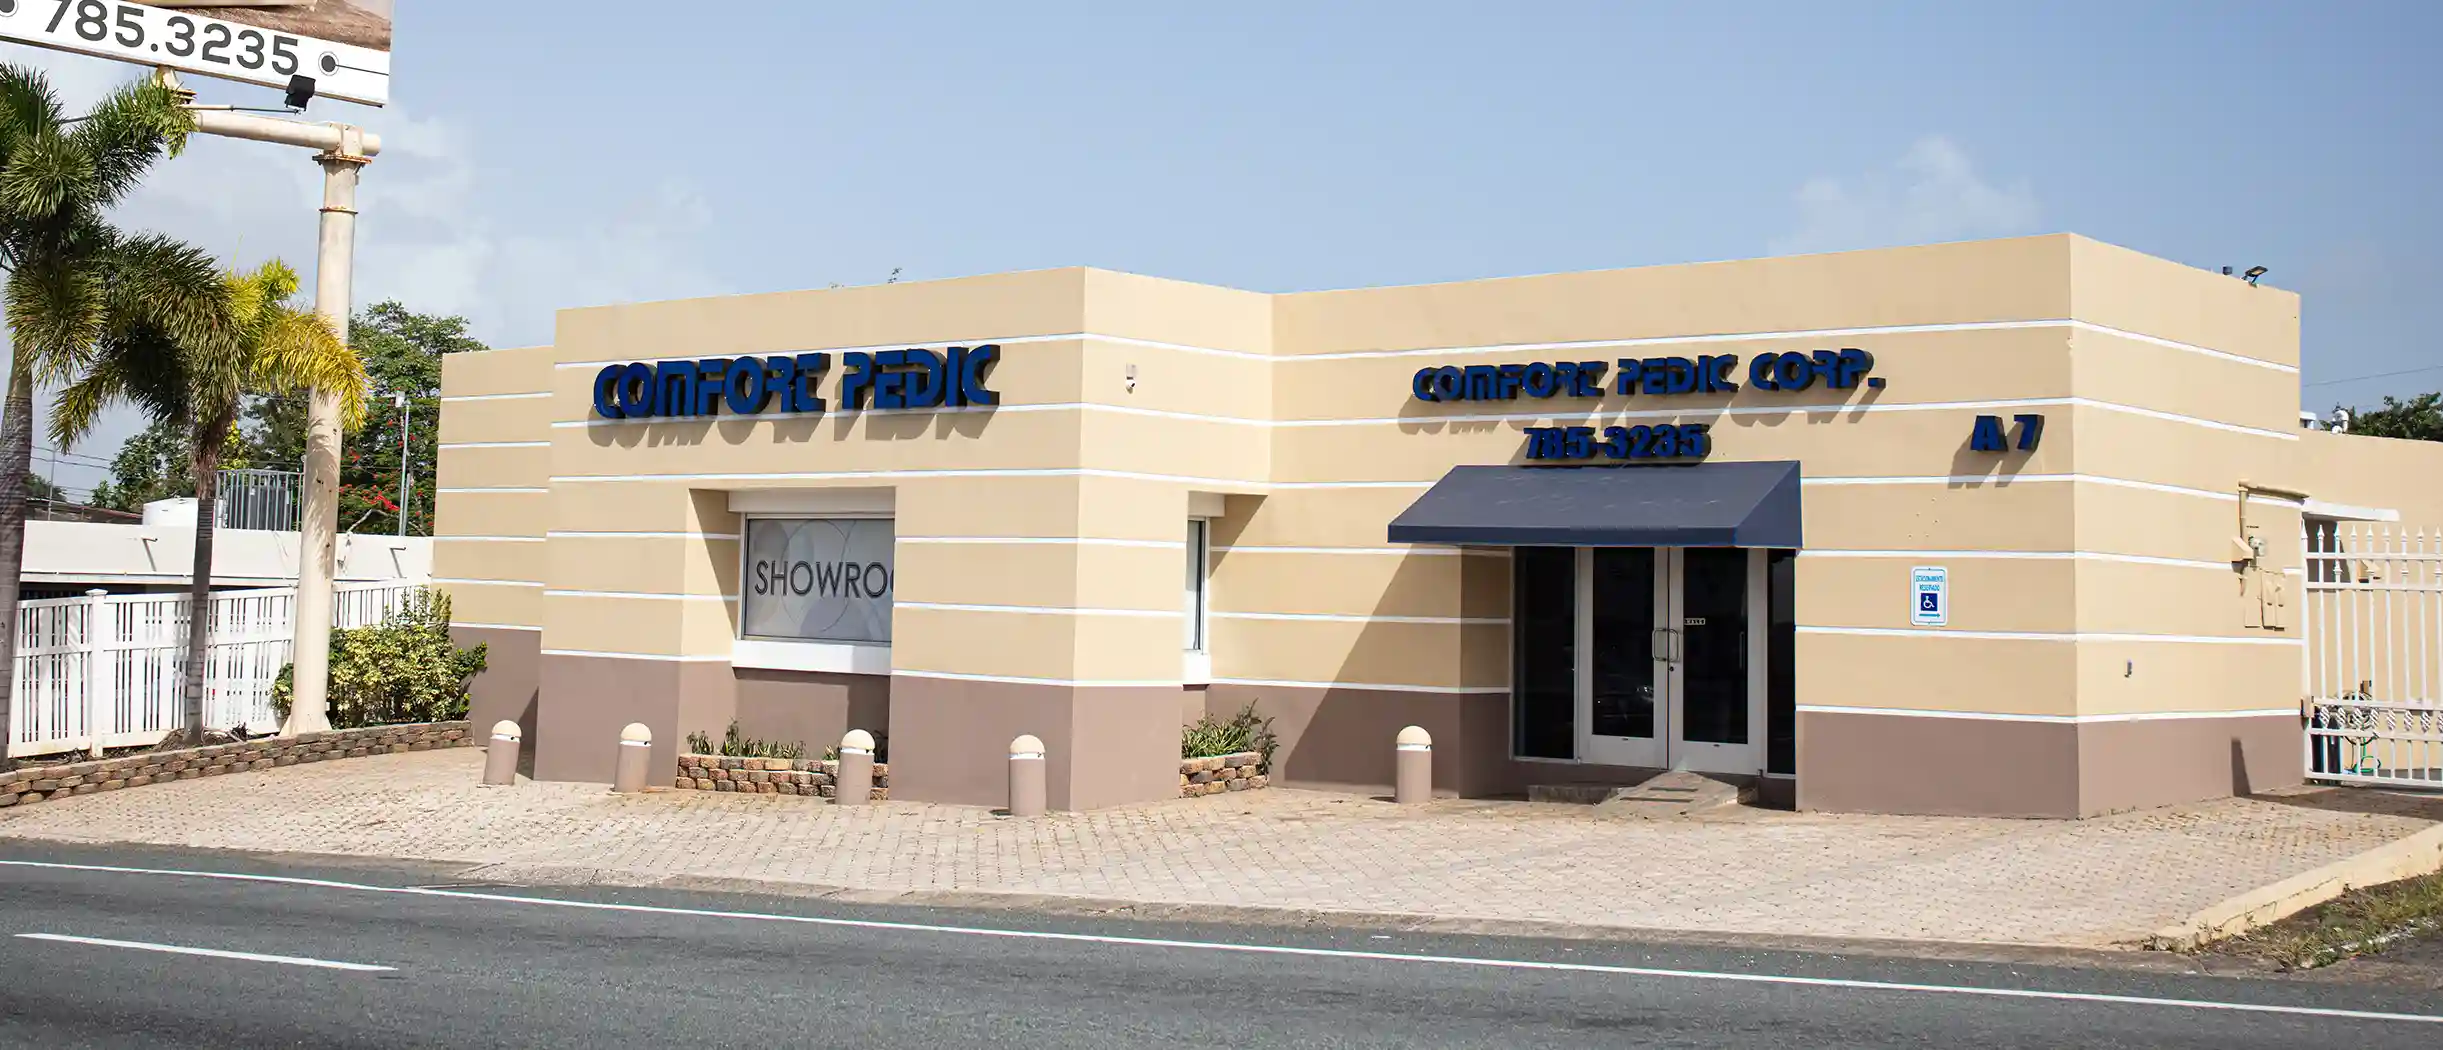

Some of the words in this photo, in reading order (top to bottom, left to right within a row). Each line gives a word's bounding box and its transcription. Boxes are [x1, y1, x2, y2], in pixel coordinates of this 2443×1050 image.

[593, 353, 831, 419] COMFORT
[842, 344, 1001, 410] PEDIC
[1412, 360, 1609, 402] COMFORT
[1617, 353, 1740, 396] PEDIC
[1749, 348, 1887, 392] CORP.
[1523, 423, 1711, 460] 785-3235
[754, 559, 894, 599] SHOWRO
